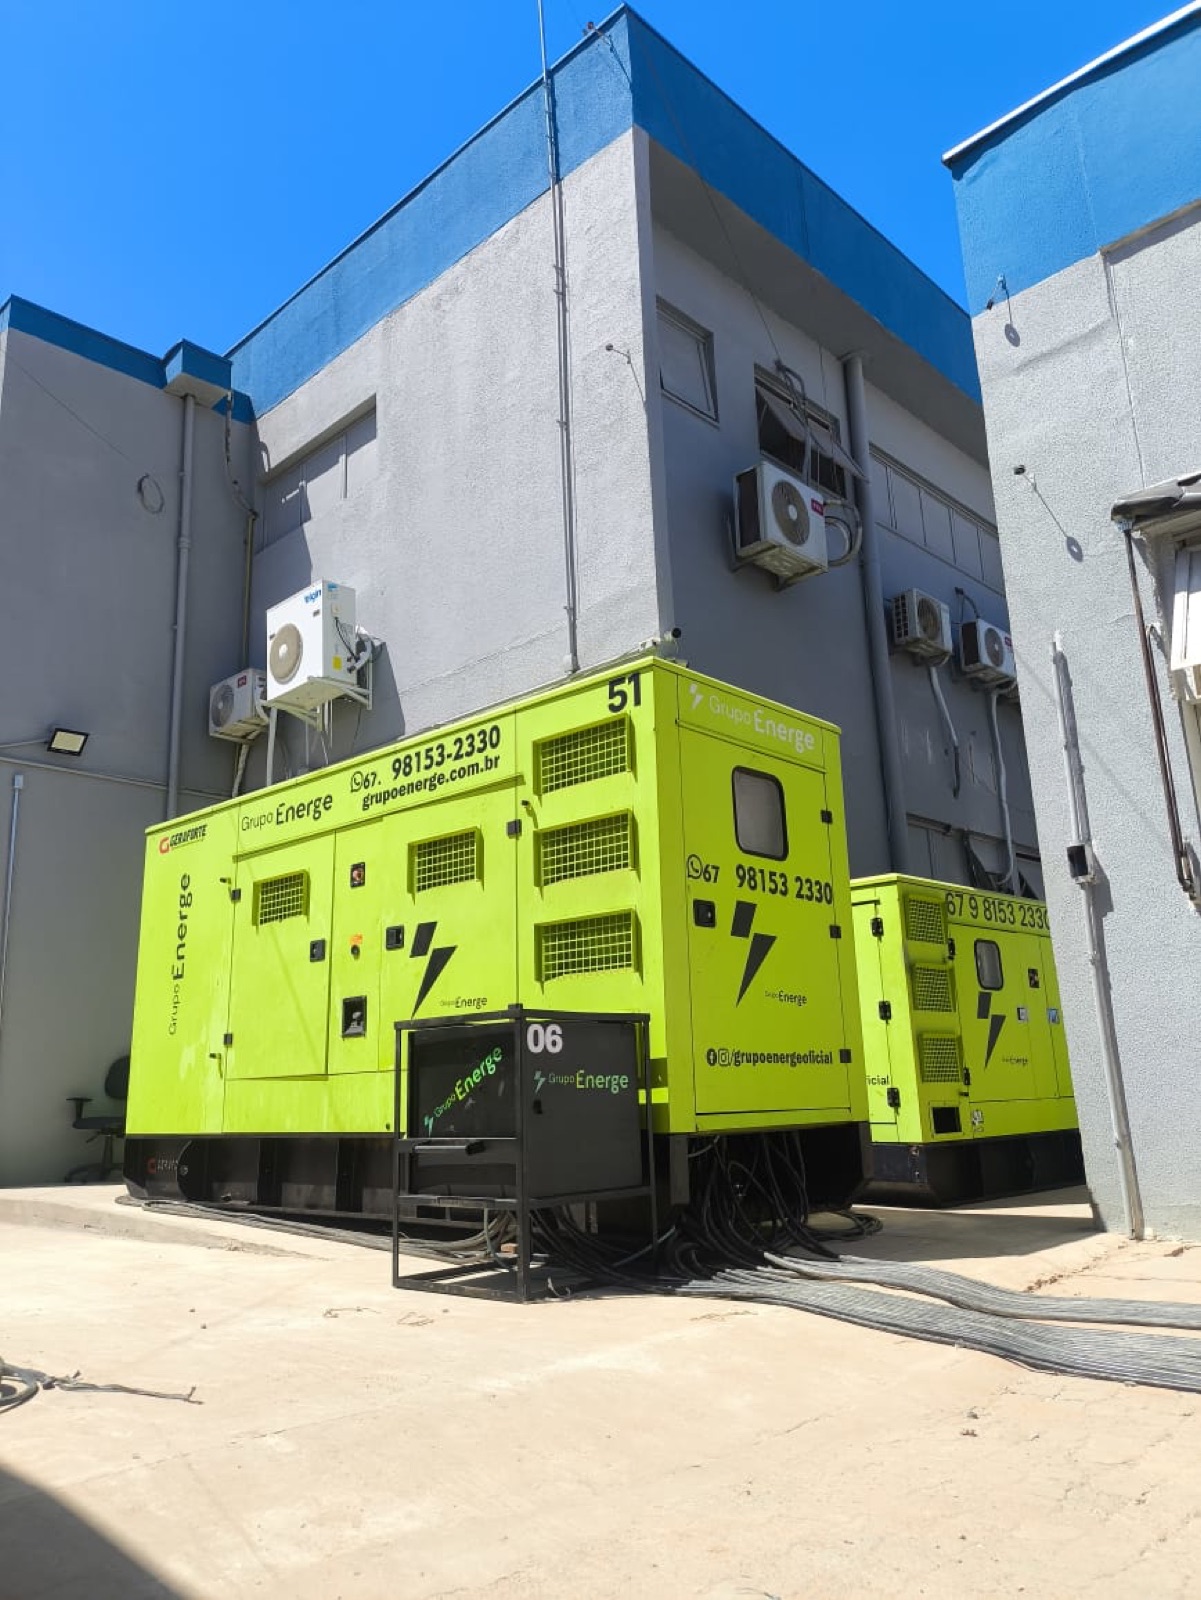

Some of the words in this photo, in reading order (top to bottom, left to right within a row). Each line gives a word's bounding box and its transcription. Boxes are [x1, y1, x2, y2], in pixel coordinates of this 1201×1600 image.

[608, 672, 642, 713] 51
[709, 695, 751, 725] Grupo
[753, 709, 815, 754] Energe
[392, 725, 500, 780] 98153-2330
[362, 754, 500, 811] grupoenerge.com.br
[241, 812, 273, 831] Grupo
[275, 794, 333, 826] Energe
[702, 864, 720, 883] 67
[735, 863, 788, 897] 98153
[794, 875, 833, 905] 2330
[171, 872, 193, 981] Energe
[945, 890, 964, 916] 67
[968, 895, 979, 920] 9
[982, 897, 1016, 926] 8153
[168, 983, 180, 1036] Grupo
[526, 1023, 563, 1054] 06
[455, 1047, 502, 1101] Energe
[548, 1072, 575, 1086] Grupo
[576, 1069, 629, 1094] Energe
